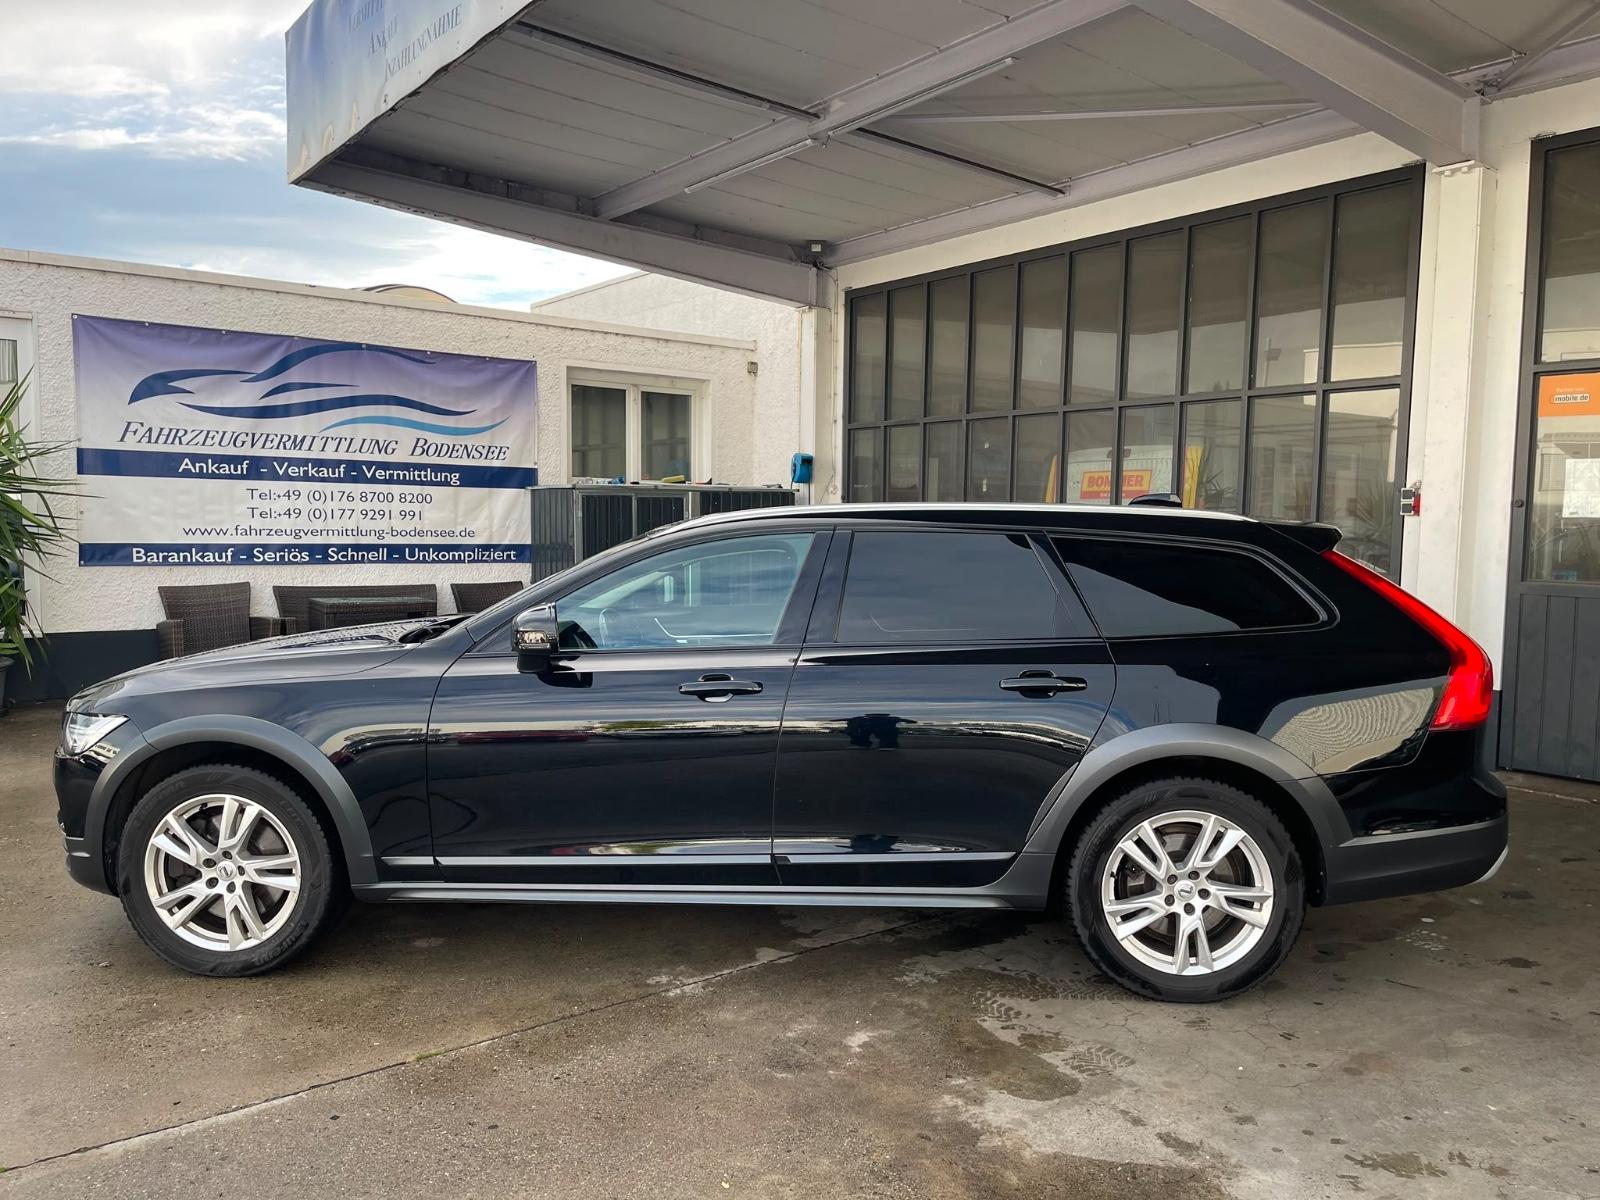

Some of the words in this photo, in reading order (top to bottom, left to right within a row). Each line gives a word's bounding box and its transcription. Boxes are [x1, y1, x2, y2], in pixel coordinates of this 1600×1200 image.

[117, 421, 398, 456] FAHRZEUGVERMITTLUNG
[409, 437, 510, 461] BODENSEE
[178, 457, 250, 475] Ankauf
[272, 461, 347, 479] Verkauf
[361, 464, 461, 486] Vermittlung
[1087, 474, 1144, 488] BOER
[359, 491, 395, 503] 8700
[398, 492, 433, 504] 8200
[360, 508, 392, 520] 9291
[399, 509, 423, 521] 991
[183, 525, 476, 540] www.fahrzeugvermittlung-bodensee.de
[132, 547, 235, 563] Barankauf
[253, 547, 310, 563] Seriös
[327, 547, 387, 562] Schnell
[405, 548, 517, 564] Unkompliziert
